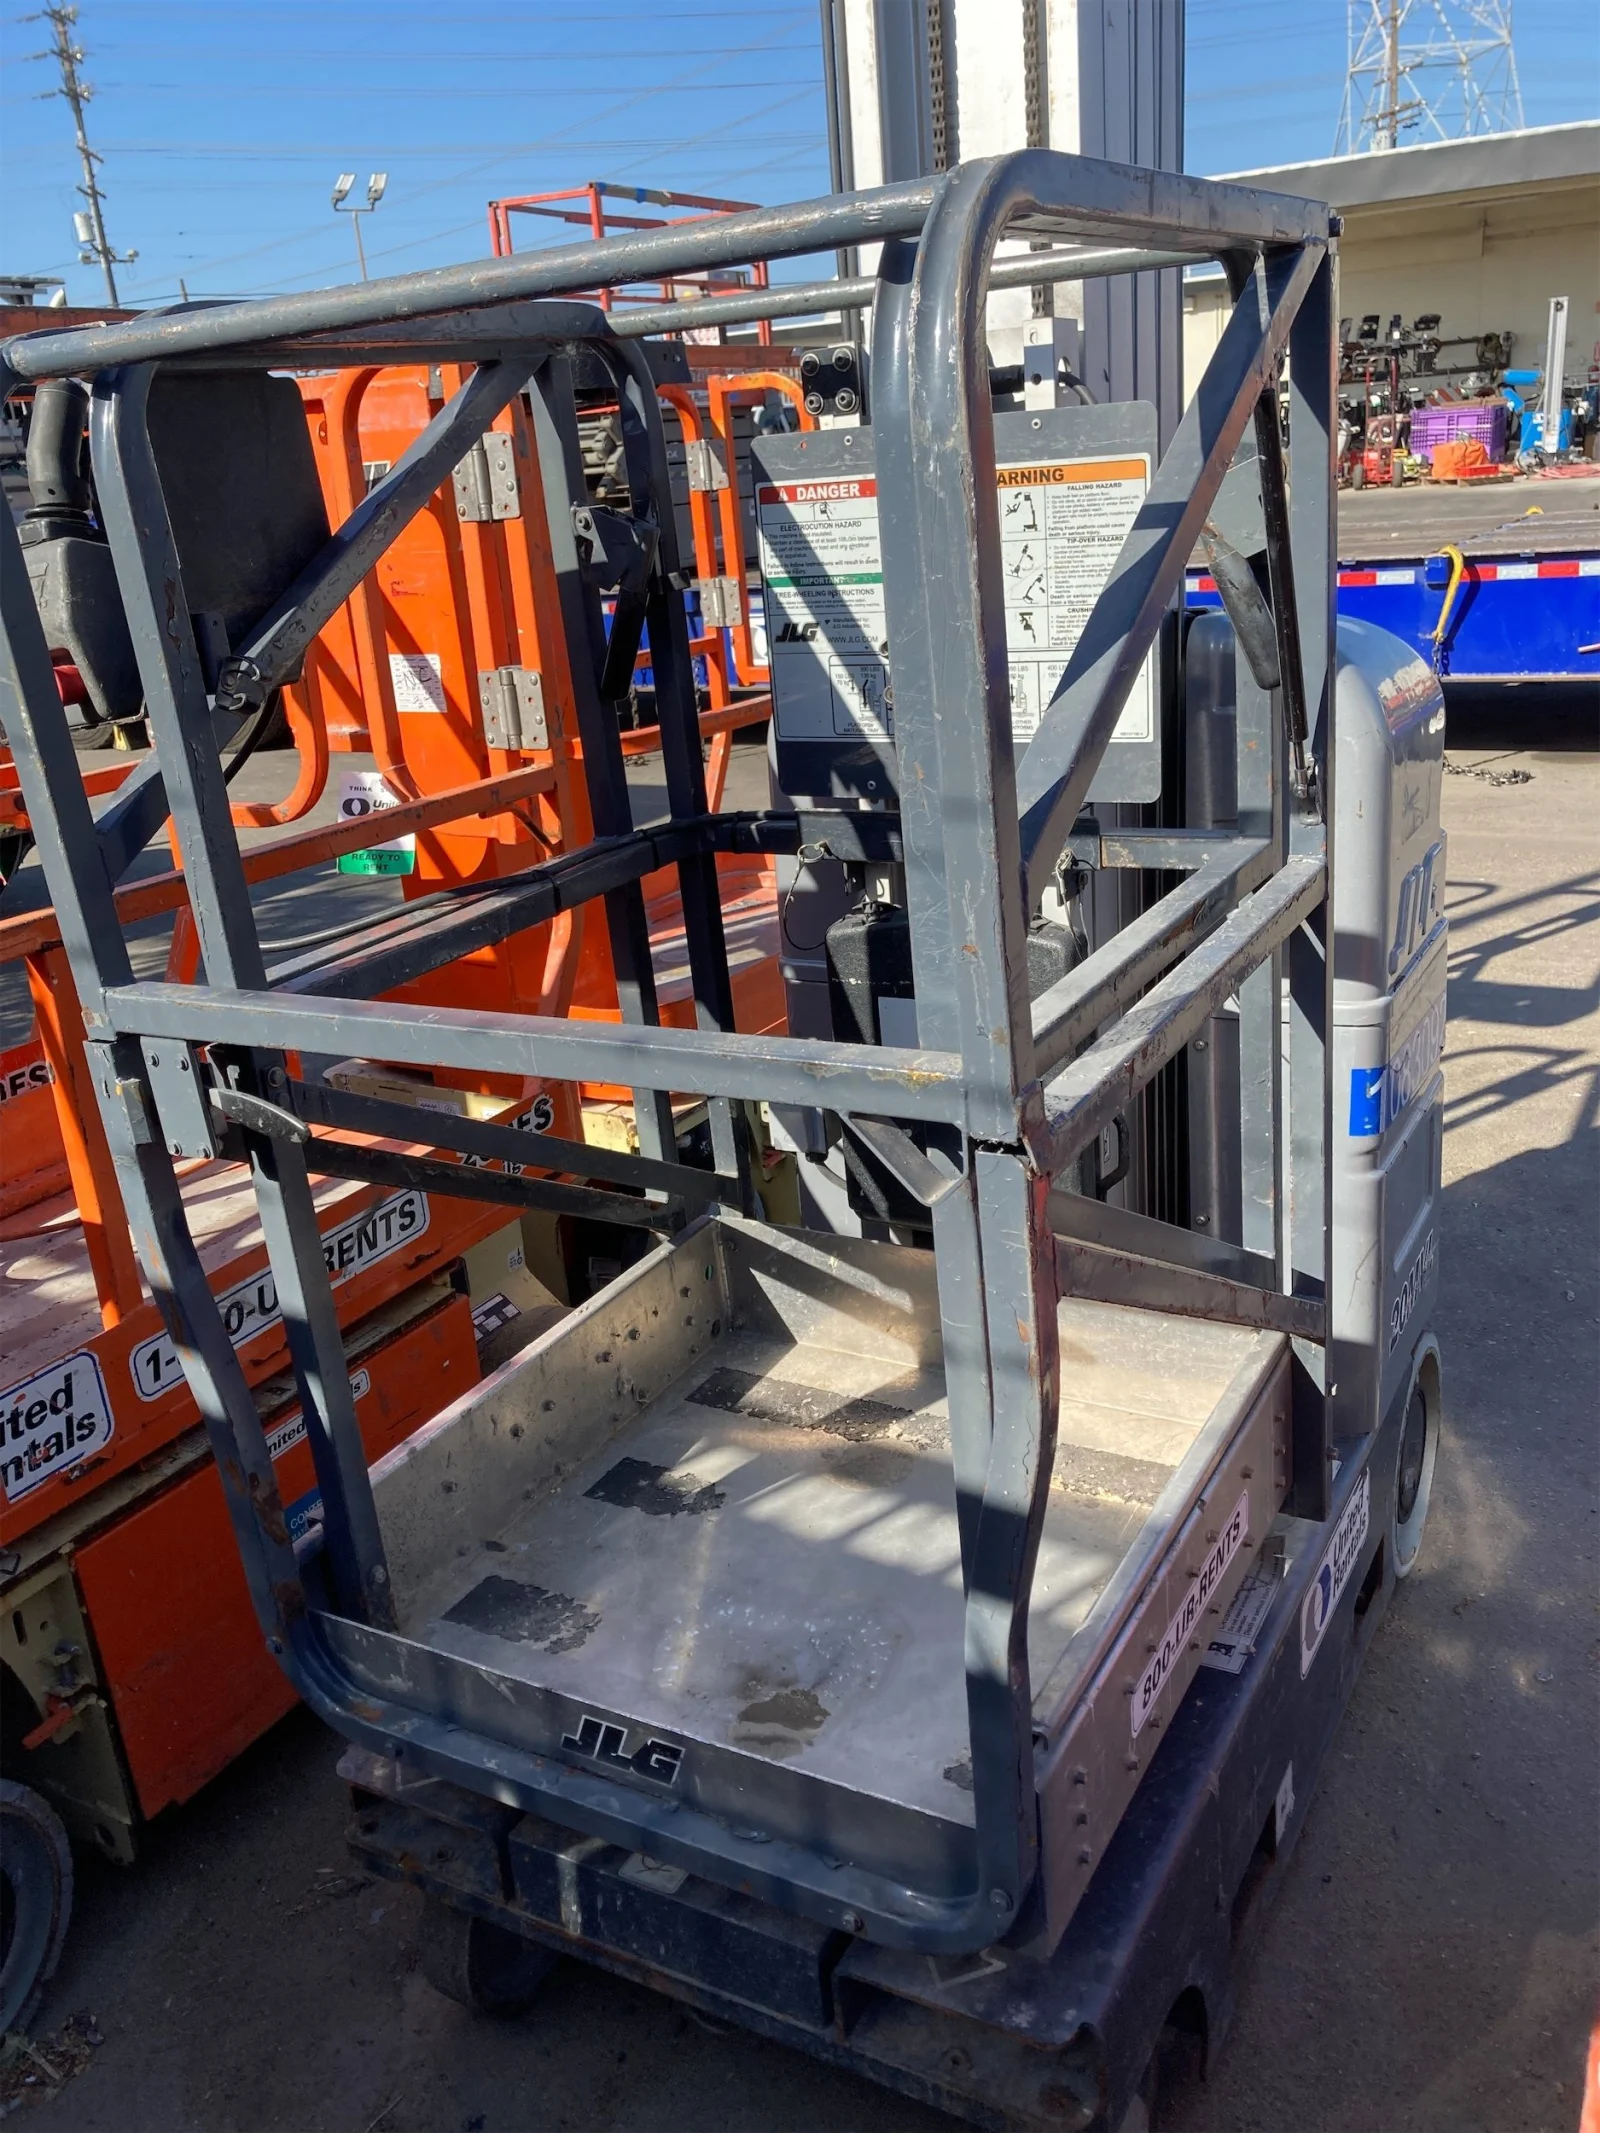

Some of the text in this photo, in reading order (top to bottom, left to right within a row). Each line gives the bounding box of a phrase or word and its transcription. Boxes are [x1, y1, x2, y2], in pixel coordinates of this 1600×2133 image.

[997, 468, 1065, 485] ARNING
[796, 483, 861, 500] DANGER
[1096, 482, 1123, 490] HAZARD
[780, 521, 862, 532] ELECTROCUTION HAZARD
[800, 577, 844, 585] IMPORTANT
[776, 589, 875, 599] FREE-WHEELING INSTRUCTIONS
[776, 623, 820, 643] JLG
[352, 853, 385, 861] READY
[363, 864, 389, 872] RENT
[0, 1371, 74, 1449] ited
[268, 1419, 307, 1456] nited
[1333, 1476, 1365, 1568] United
[1332, 1511, 1367, 1599] Rentals
[560, 1714, 686, 1789] JLG
